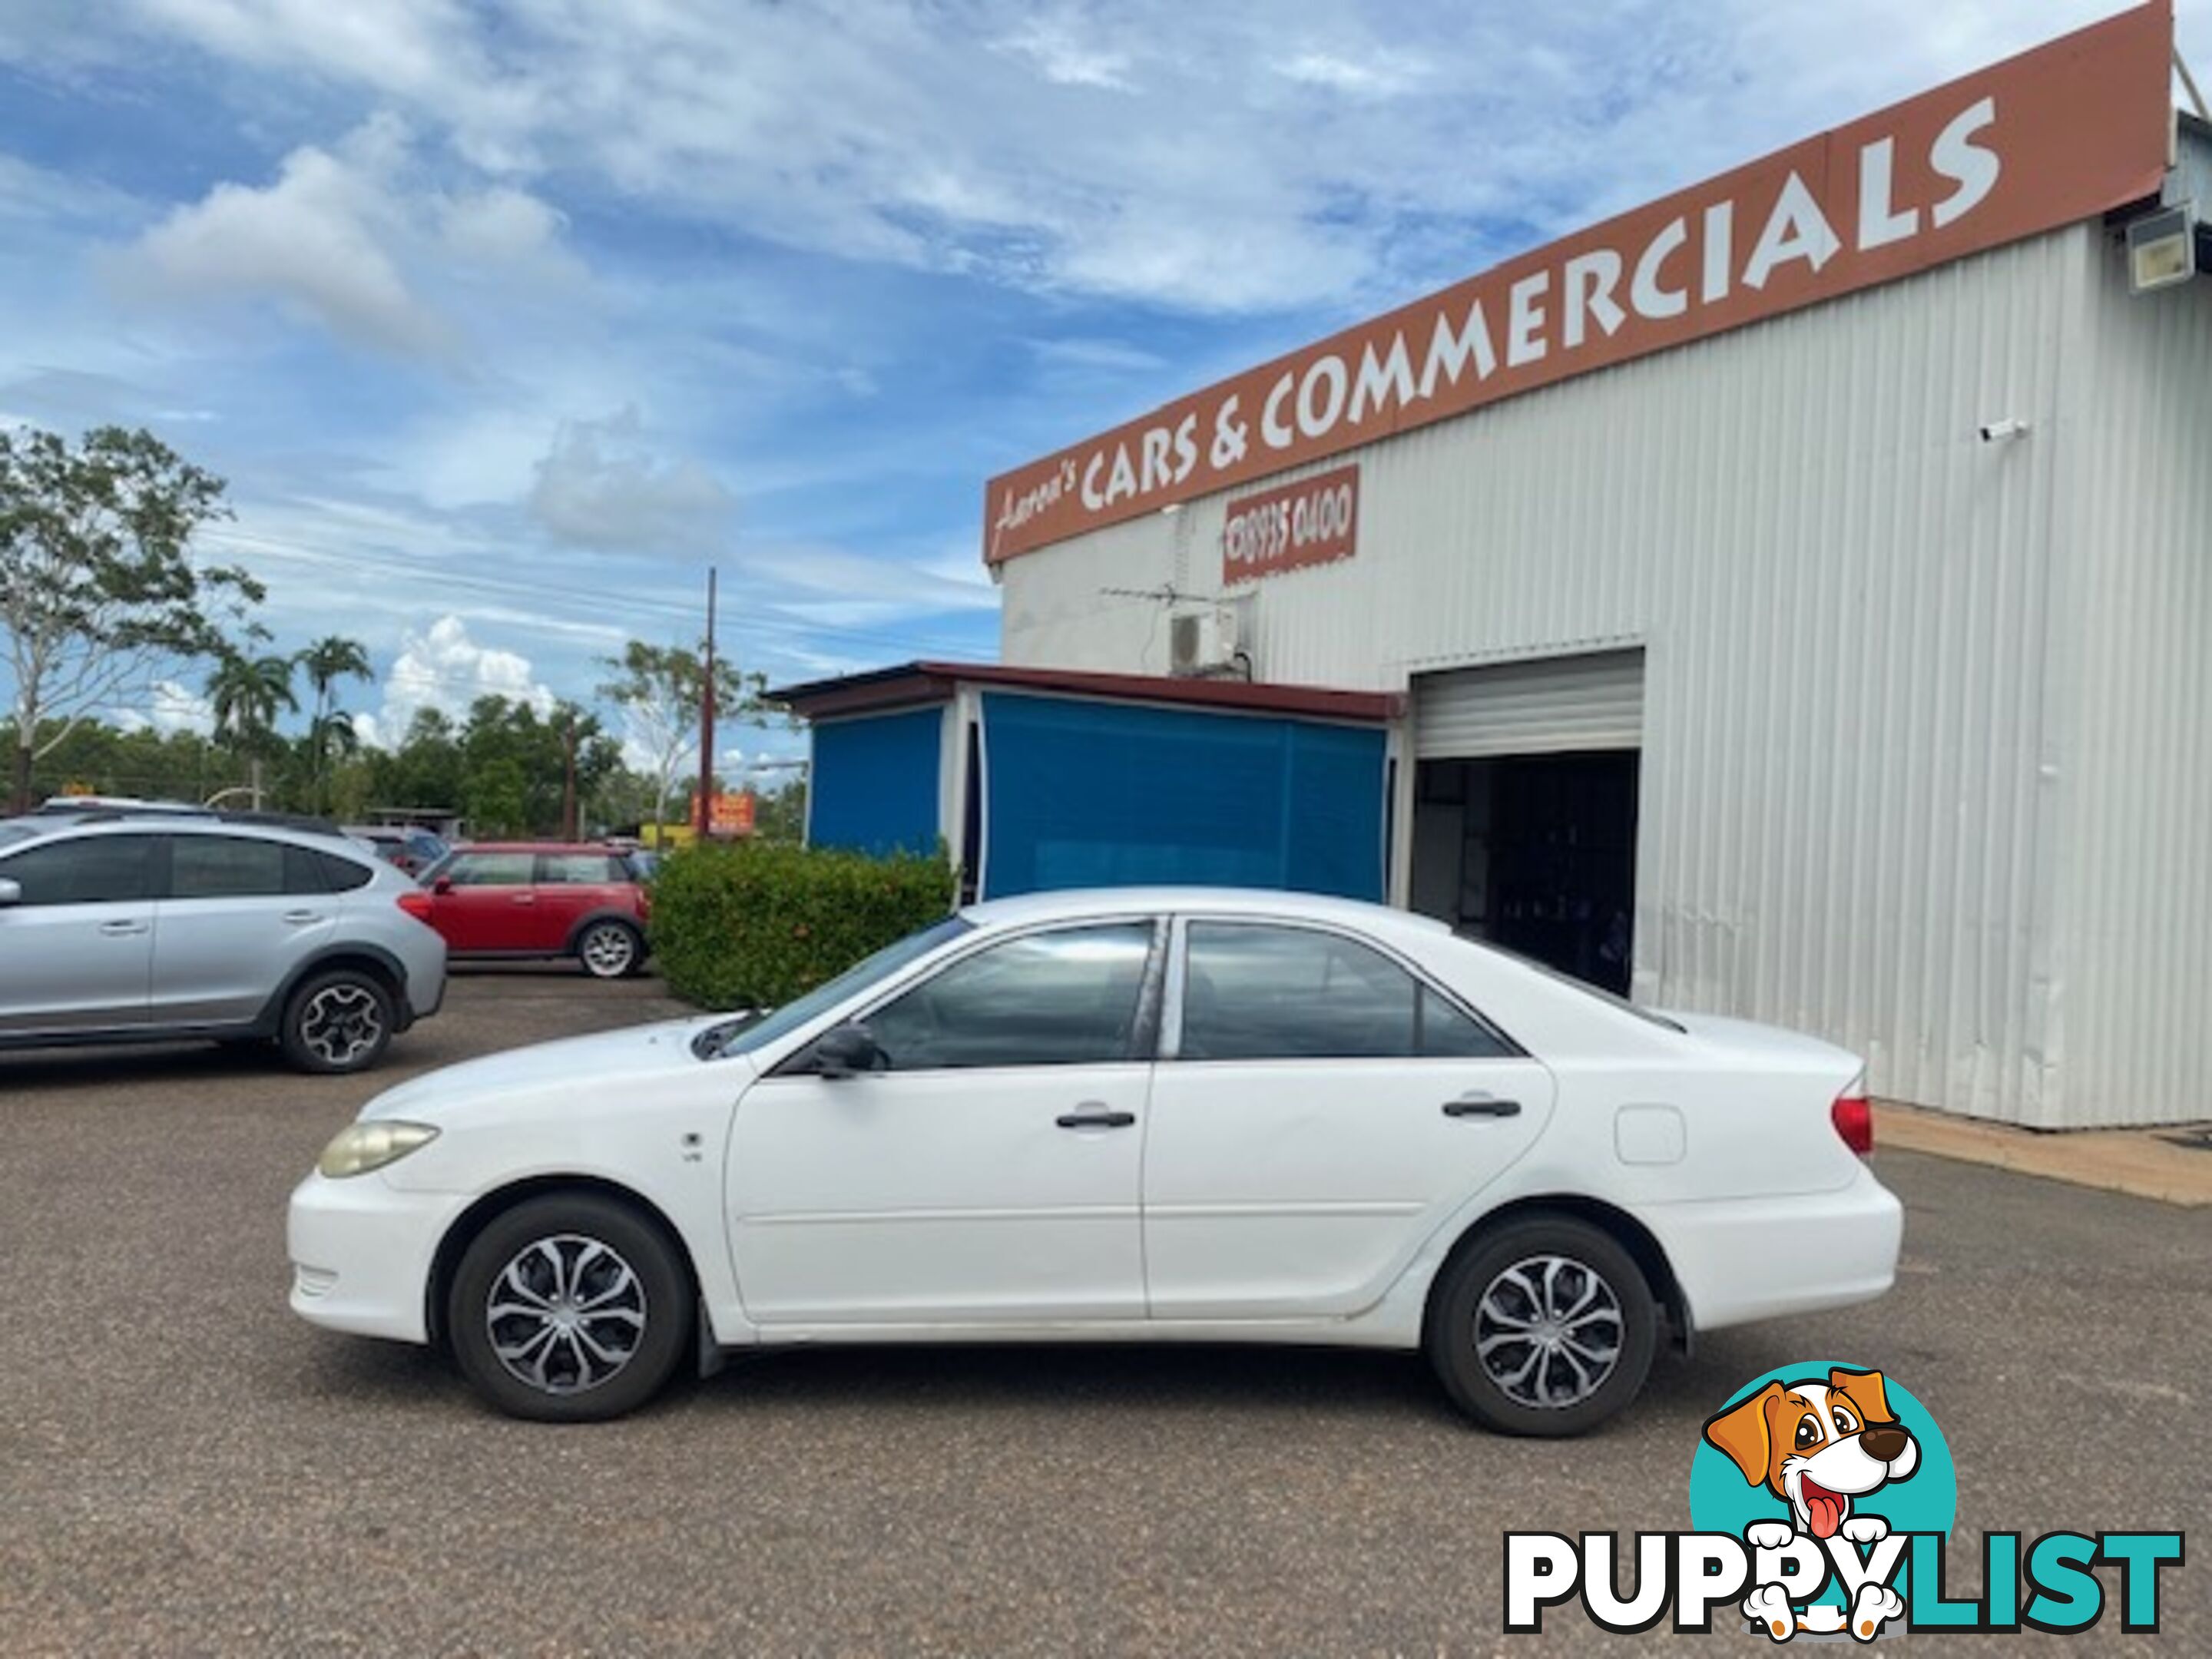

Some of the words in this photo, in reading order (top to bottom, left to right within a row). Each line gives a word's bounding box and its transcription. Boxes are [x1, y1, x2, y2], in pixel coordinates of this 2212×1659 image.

[1080, 413, 1198, 512] CARS
[1210, 395, 1247, 469] &
[1261, 96, 2001, 449] COMMERCIALS
[1292, 484, 1352, 547] 0400
